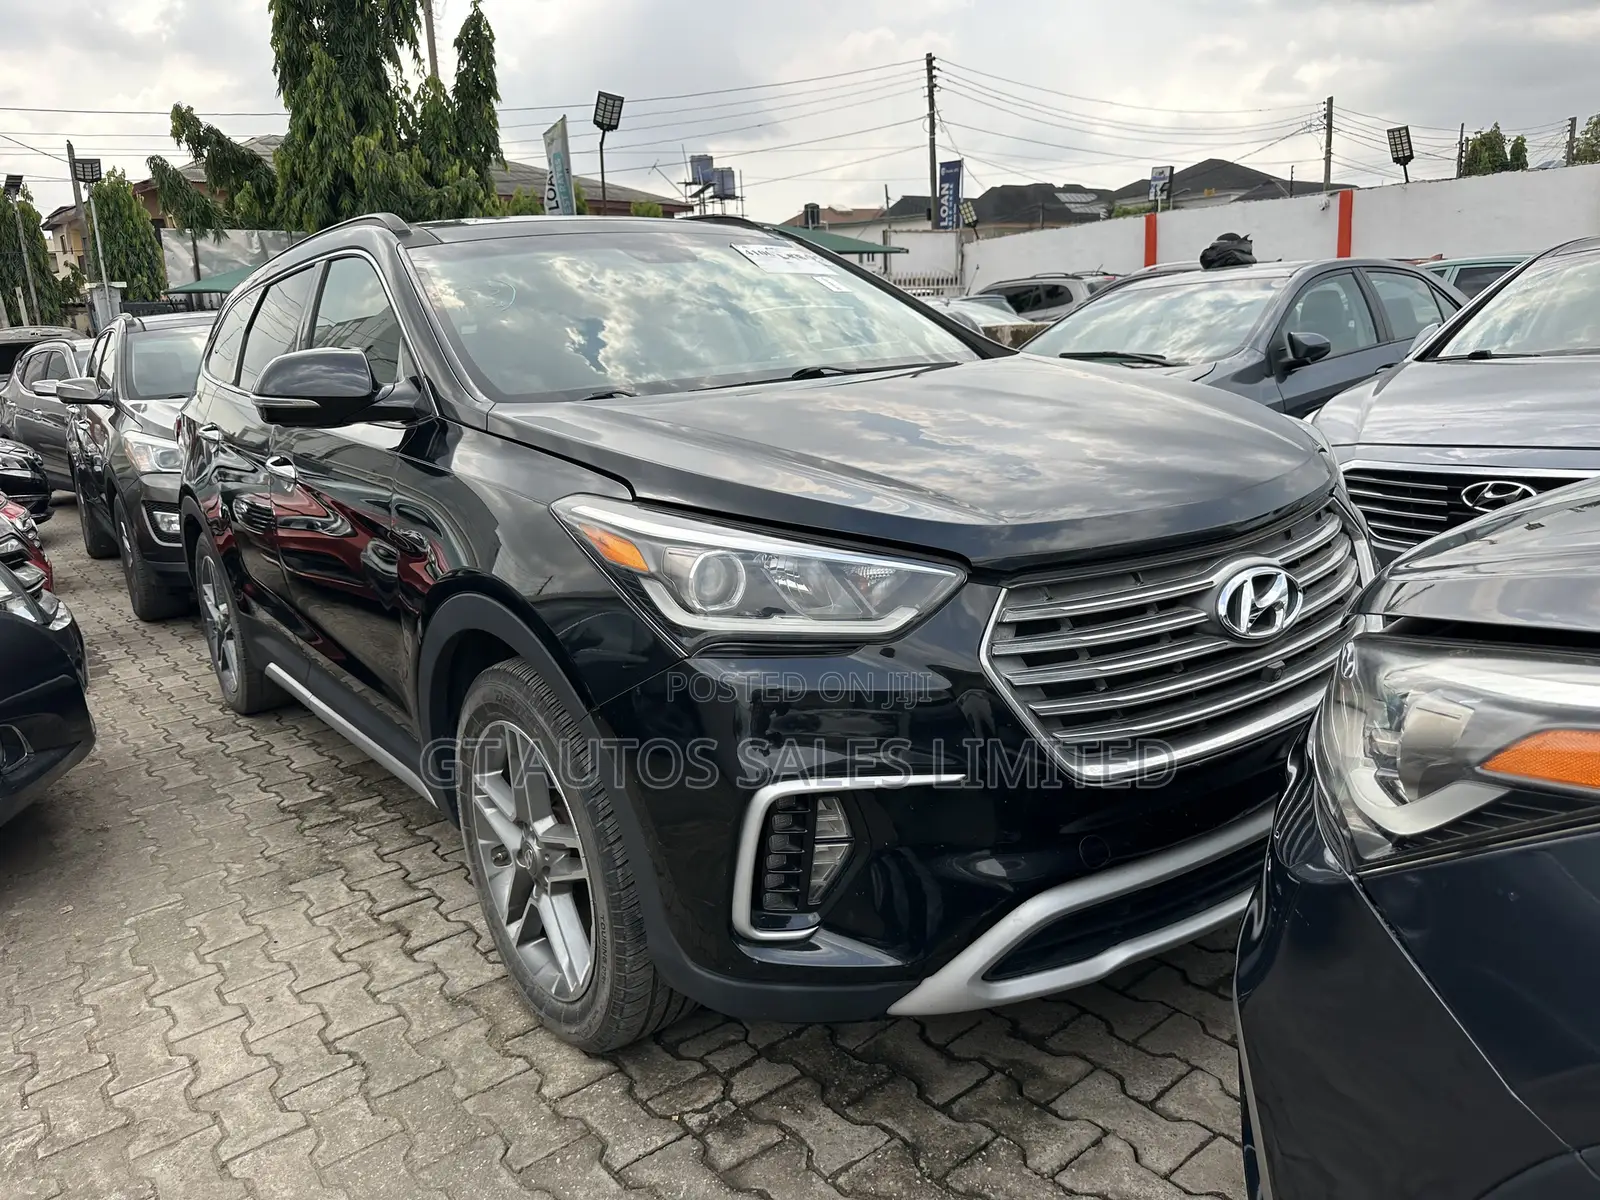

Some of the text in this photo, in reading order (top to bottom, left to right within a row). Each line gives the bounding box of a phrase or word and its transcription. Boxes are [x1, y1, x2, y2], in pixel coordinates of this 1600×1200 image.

[547, 170, 560, 210] LOA
[940, 183, 949, 226] LOAN
[600, 914, 608, 964] TOURING
